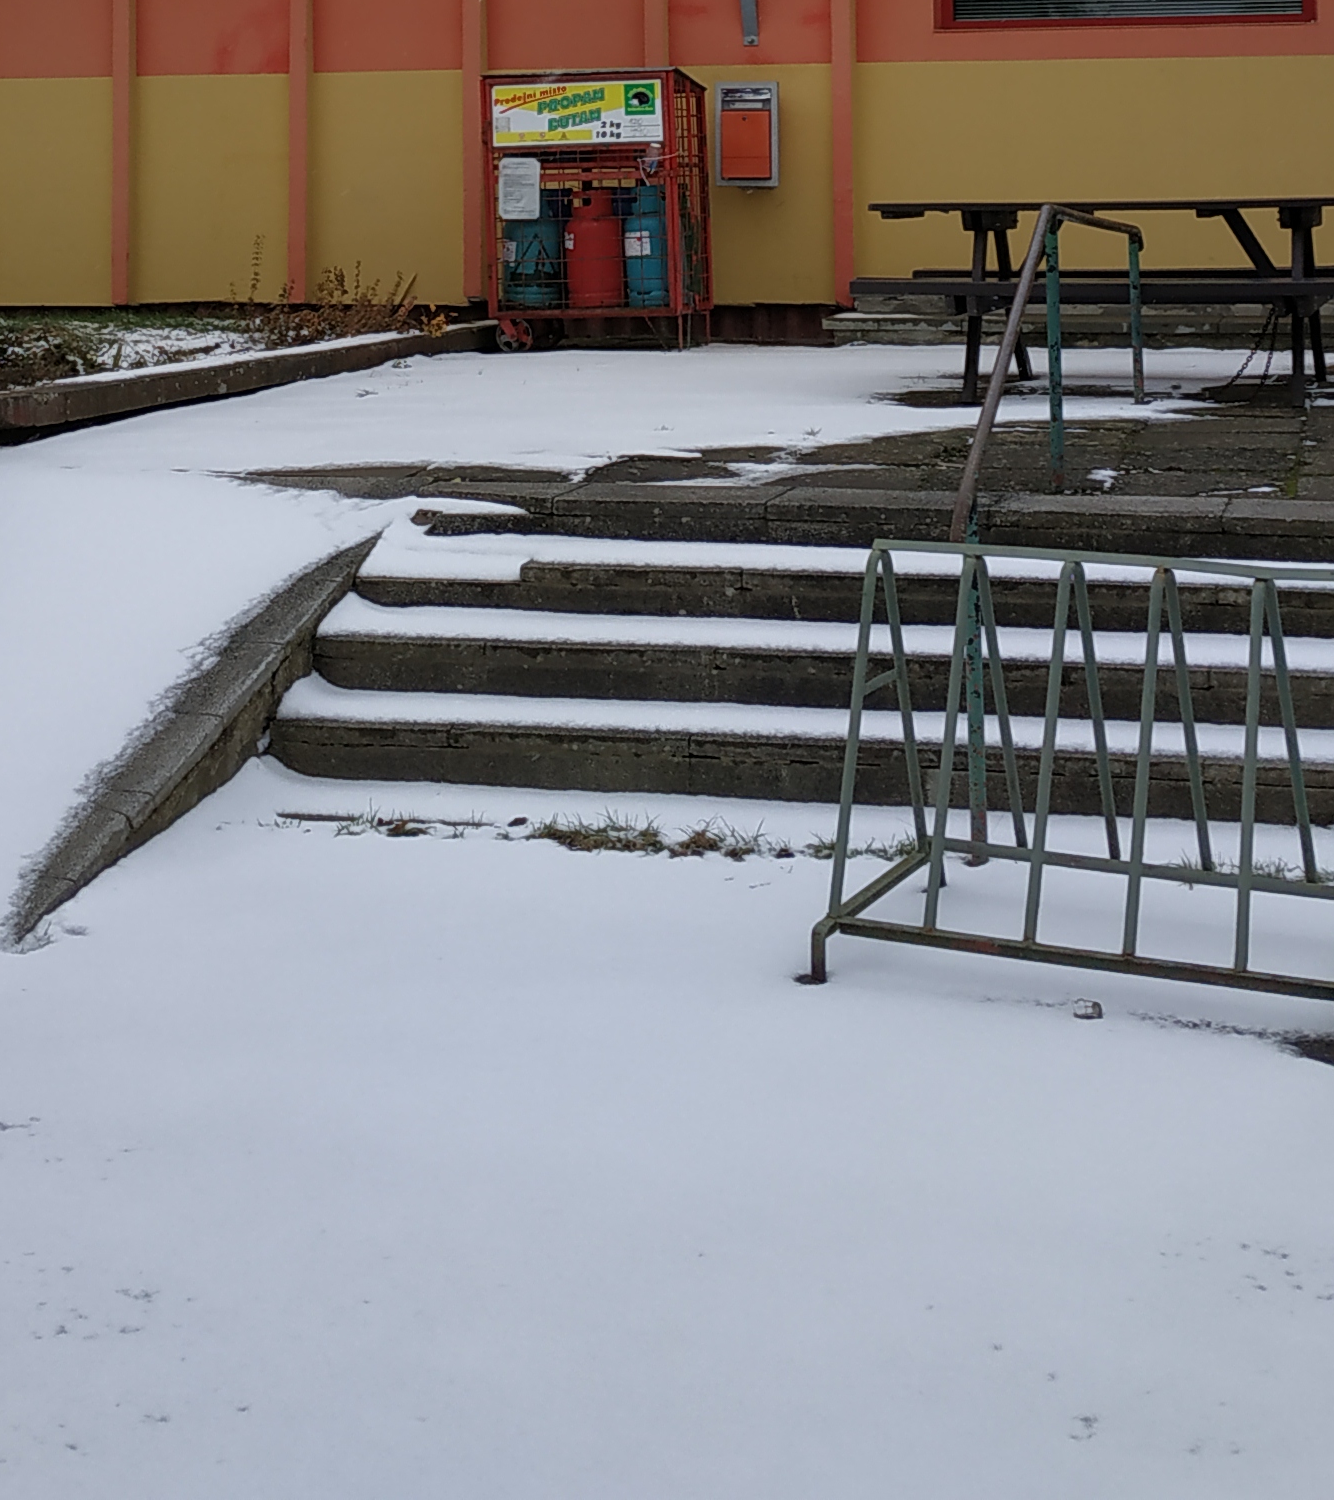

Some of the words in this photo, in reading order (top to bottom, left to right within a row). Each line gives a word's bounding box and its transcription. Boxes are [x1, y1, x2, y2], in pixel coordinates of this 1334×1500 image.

[537, 87, 605, 115] PROPAN
[547, 107, 602, 133] BUTAN
[600, 120, 607, 129] 2
[609, 120, 622, 130] kg
[596, 130, 608, 139] 10
[609, 130, 622, 140] kg
